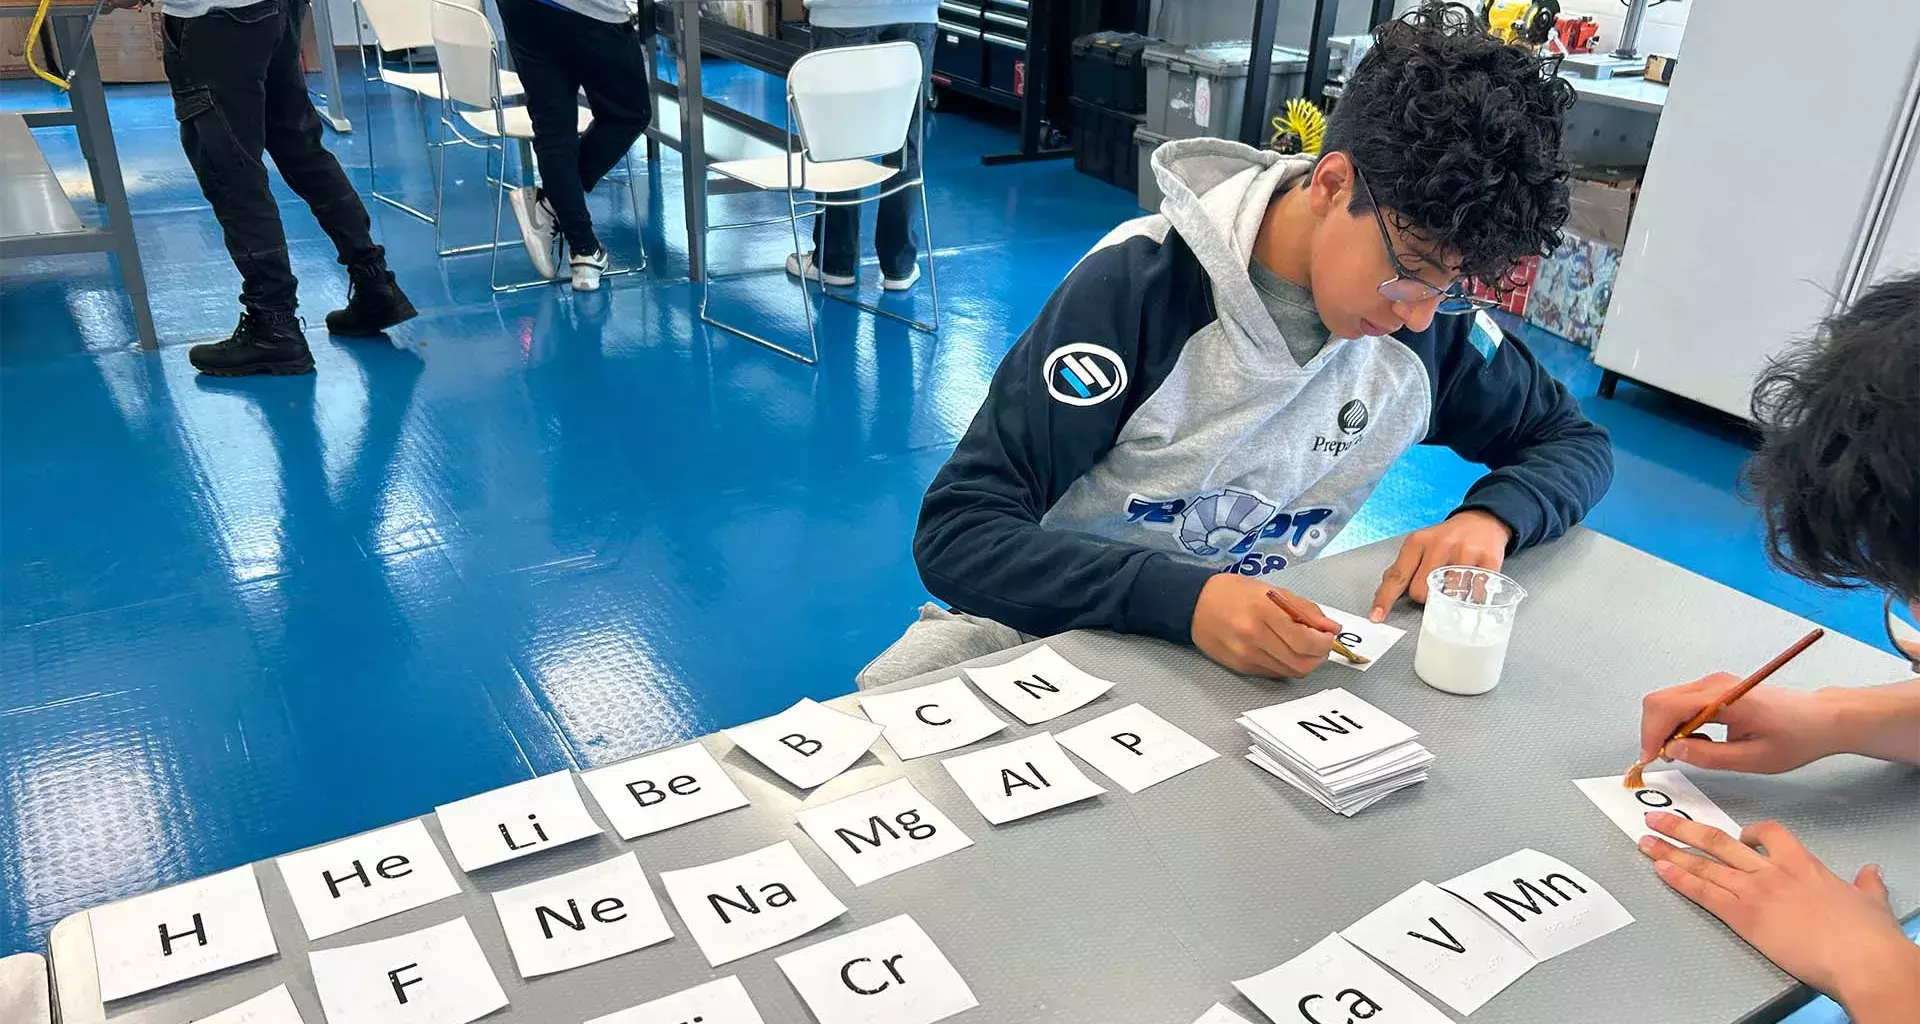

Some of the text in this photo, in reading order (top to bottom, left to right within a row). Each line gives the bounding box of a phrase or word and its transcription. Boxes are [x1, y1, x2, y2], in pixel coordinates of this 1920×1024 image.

[1335, 630, 1363, 648] e
[1013, 674, 1060, 700] N
[915, 703, 952, 727] C
[1296, 709, 1364, 743] Ni
[778, 732, 823, 758] B
[1110, 732, 1143, 757] P
[625, 774, 702, 809] Be
[1000, 761, 1052, 798] Al
[498, 813, 550, 852] Li
[834, 808, 937, 855] Mg
[322, 854, 413, 900] He
[707, 881, 798, 925] Na
[1483, 873, 1588, 924] Mn
[158, 912, 208, 957] H
[535, 896, 628, 940] Ne
[1406, 916, 1467, 954] V
[387, 962, 424, 1005] F
[840, 953, 906, 997] Cr
[1298, 987, 1384, 1024] Ca
